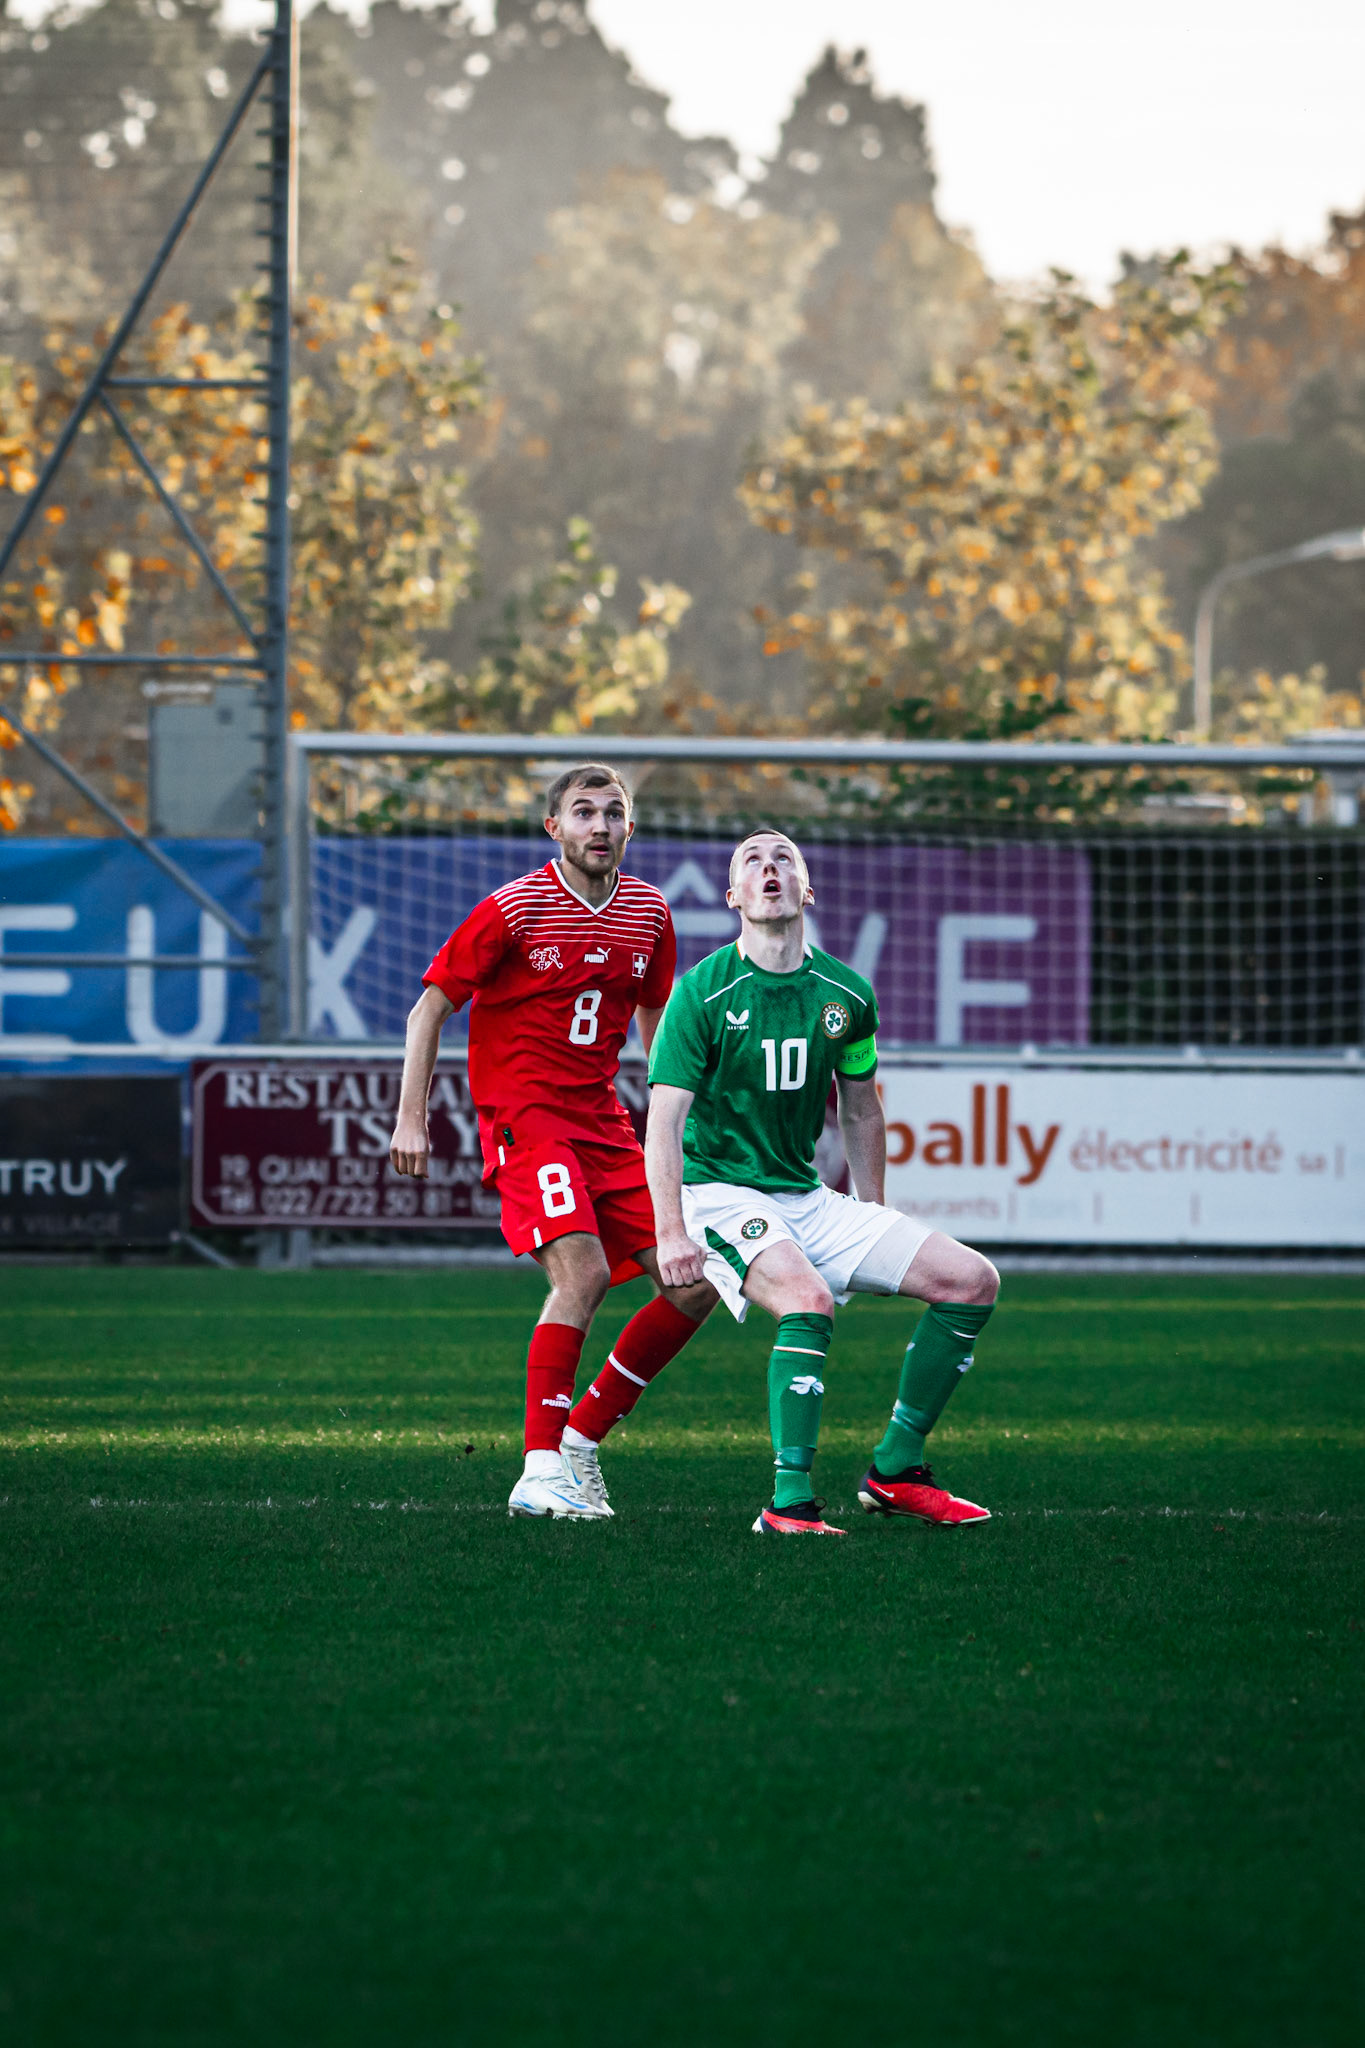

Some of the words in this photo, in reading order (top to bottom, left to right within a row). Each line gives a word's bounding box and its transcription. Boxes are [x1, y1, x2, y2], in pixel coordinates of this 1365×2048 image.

[568, 989, 603, 1046] 8
[761, 1038, 808, 1091] 10
[1070, 1127, 1283, 1173] électricité
[537, 1163, 577, 1218] 8
